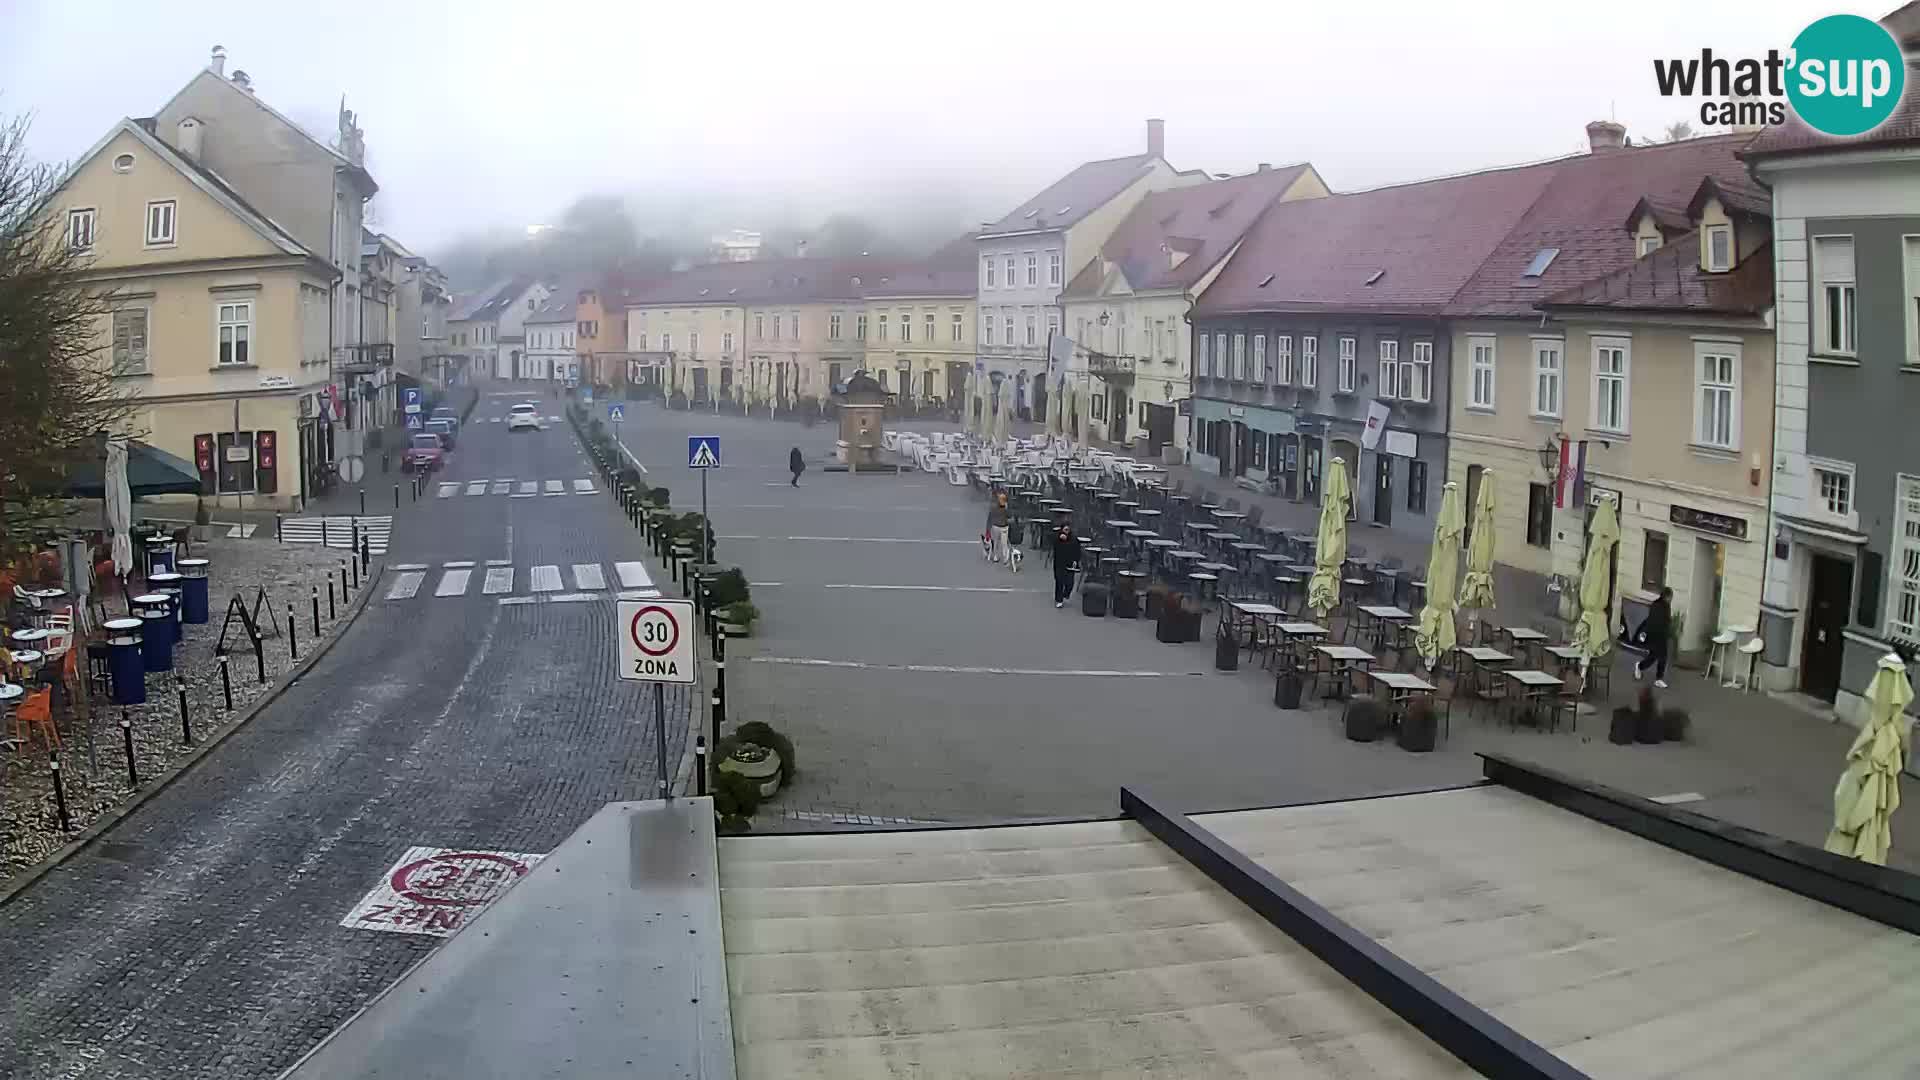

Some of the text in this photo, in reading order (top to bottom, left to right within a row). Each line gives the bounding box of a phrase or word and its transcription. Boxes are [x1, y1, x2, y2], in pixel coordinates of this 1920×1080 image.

[408, 391, 417, 402] P
[644, 621, 668, 642] 30
[634, 659, 678, 676] ZONA
[360, 903, 467, 931] ZON
